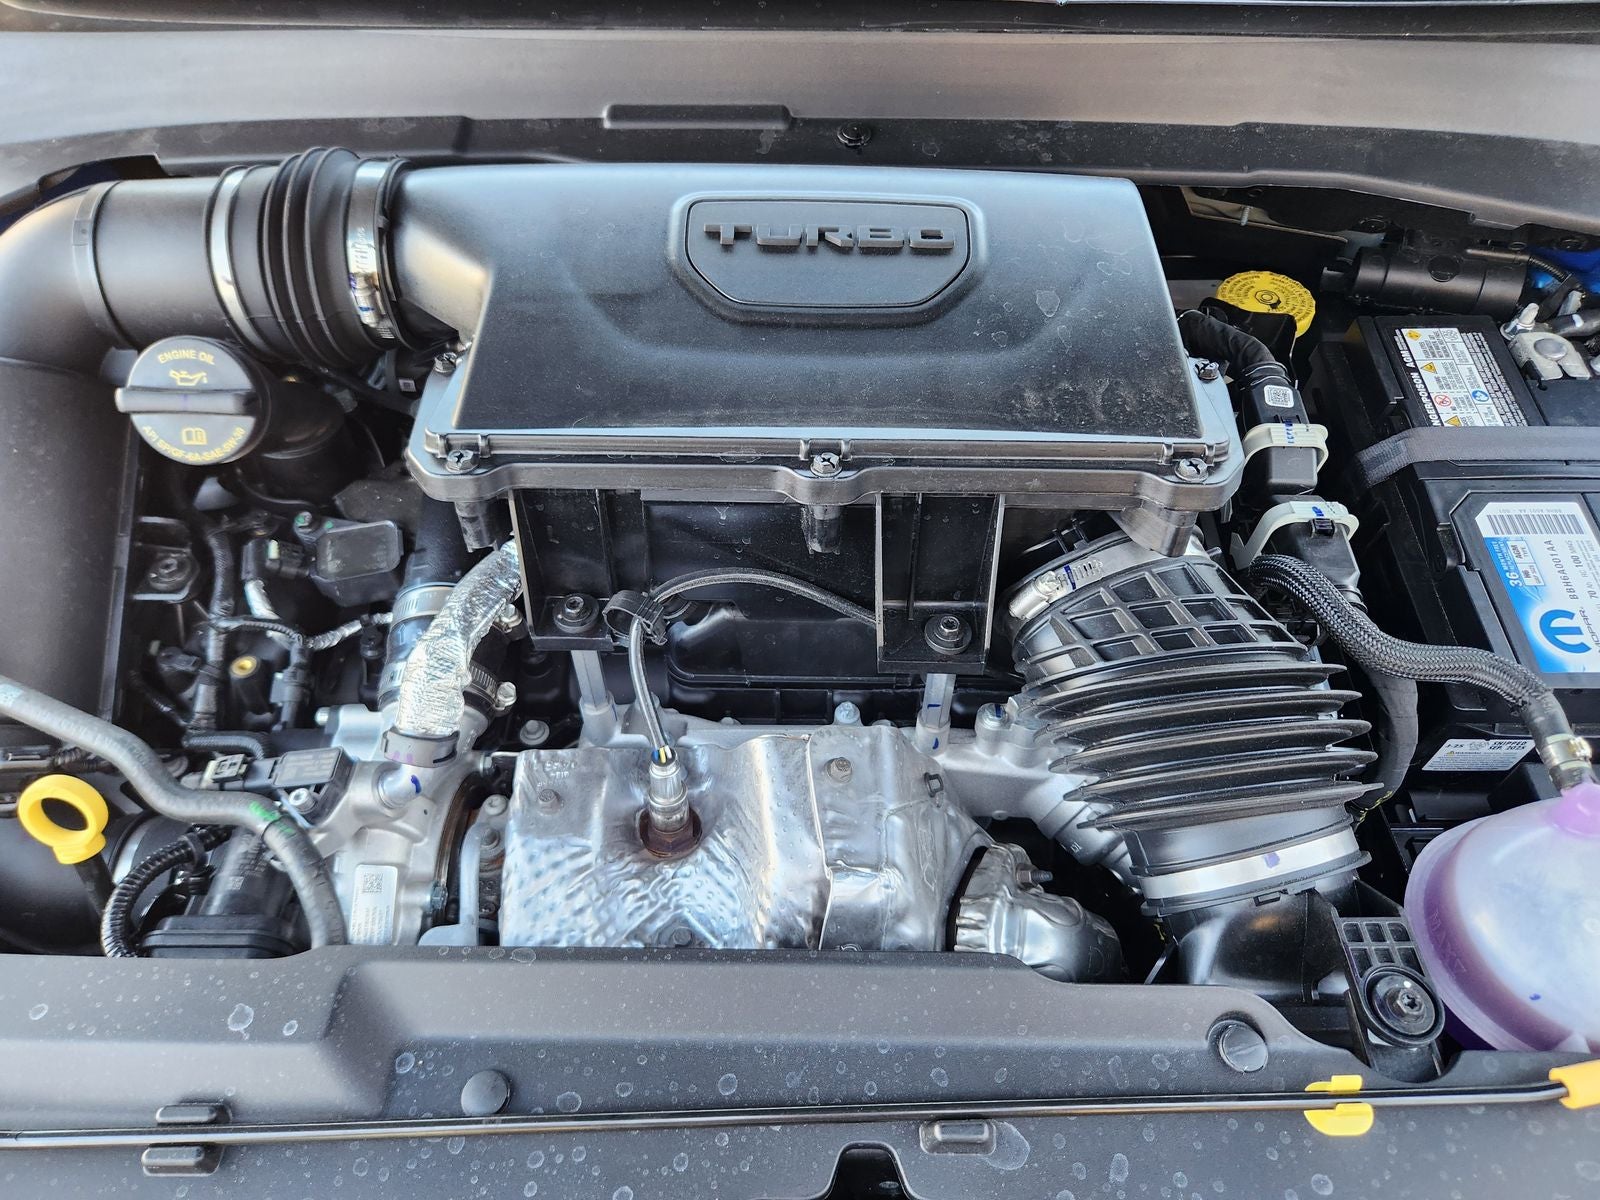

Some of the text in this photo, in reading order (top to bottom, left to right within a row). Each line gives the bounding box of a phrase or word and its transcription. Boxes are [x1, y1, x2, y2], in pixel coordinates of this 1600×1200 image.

[703, 223, 956, 249] TURBO
[158, 349, 215, 365] ENGINE OIL
[1400, 350, 1416, 368] AGM
[1410, 372, 1441, 426] NGER/POISON
[142, 425, 157, 442] API
[1511, 545, 1523, 559] AGM
[1544, 540, 1579, 600] BBH6A001AA
[1571, 555, 1583, 568] 100
[1506, 572, 1522, 587] 36
[1587, 590, 1599, 599] 70
[1579, 609, 1600, 654] OPAR
